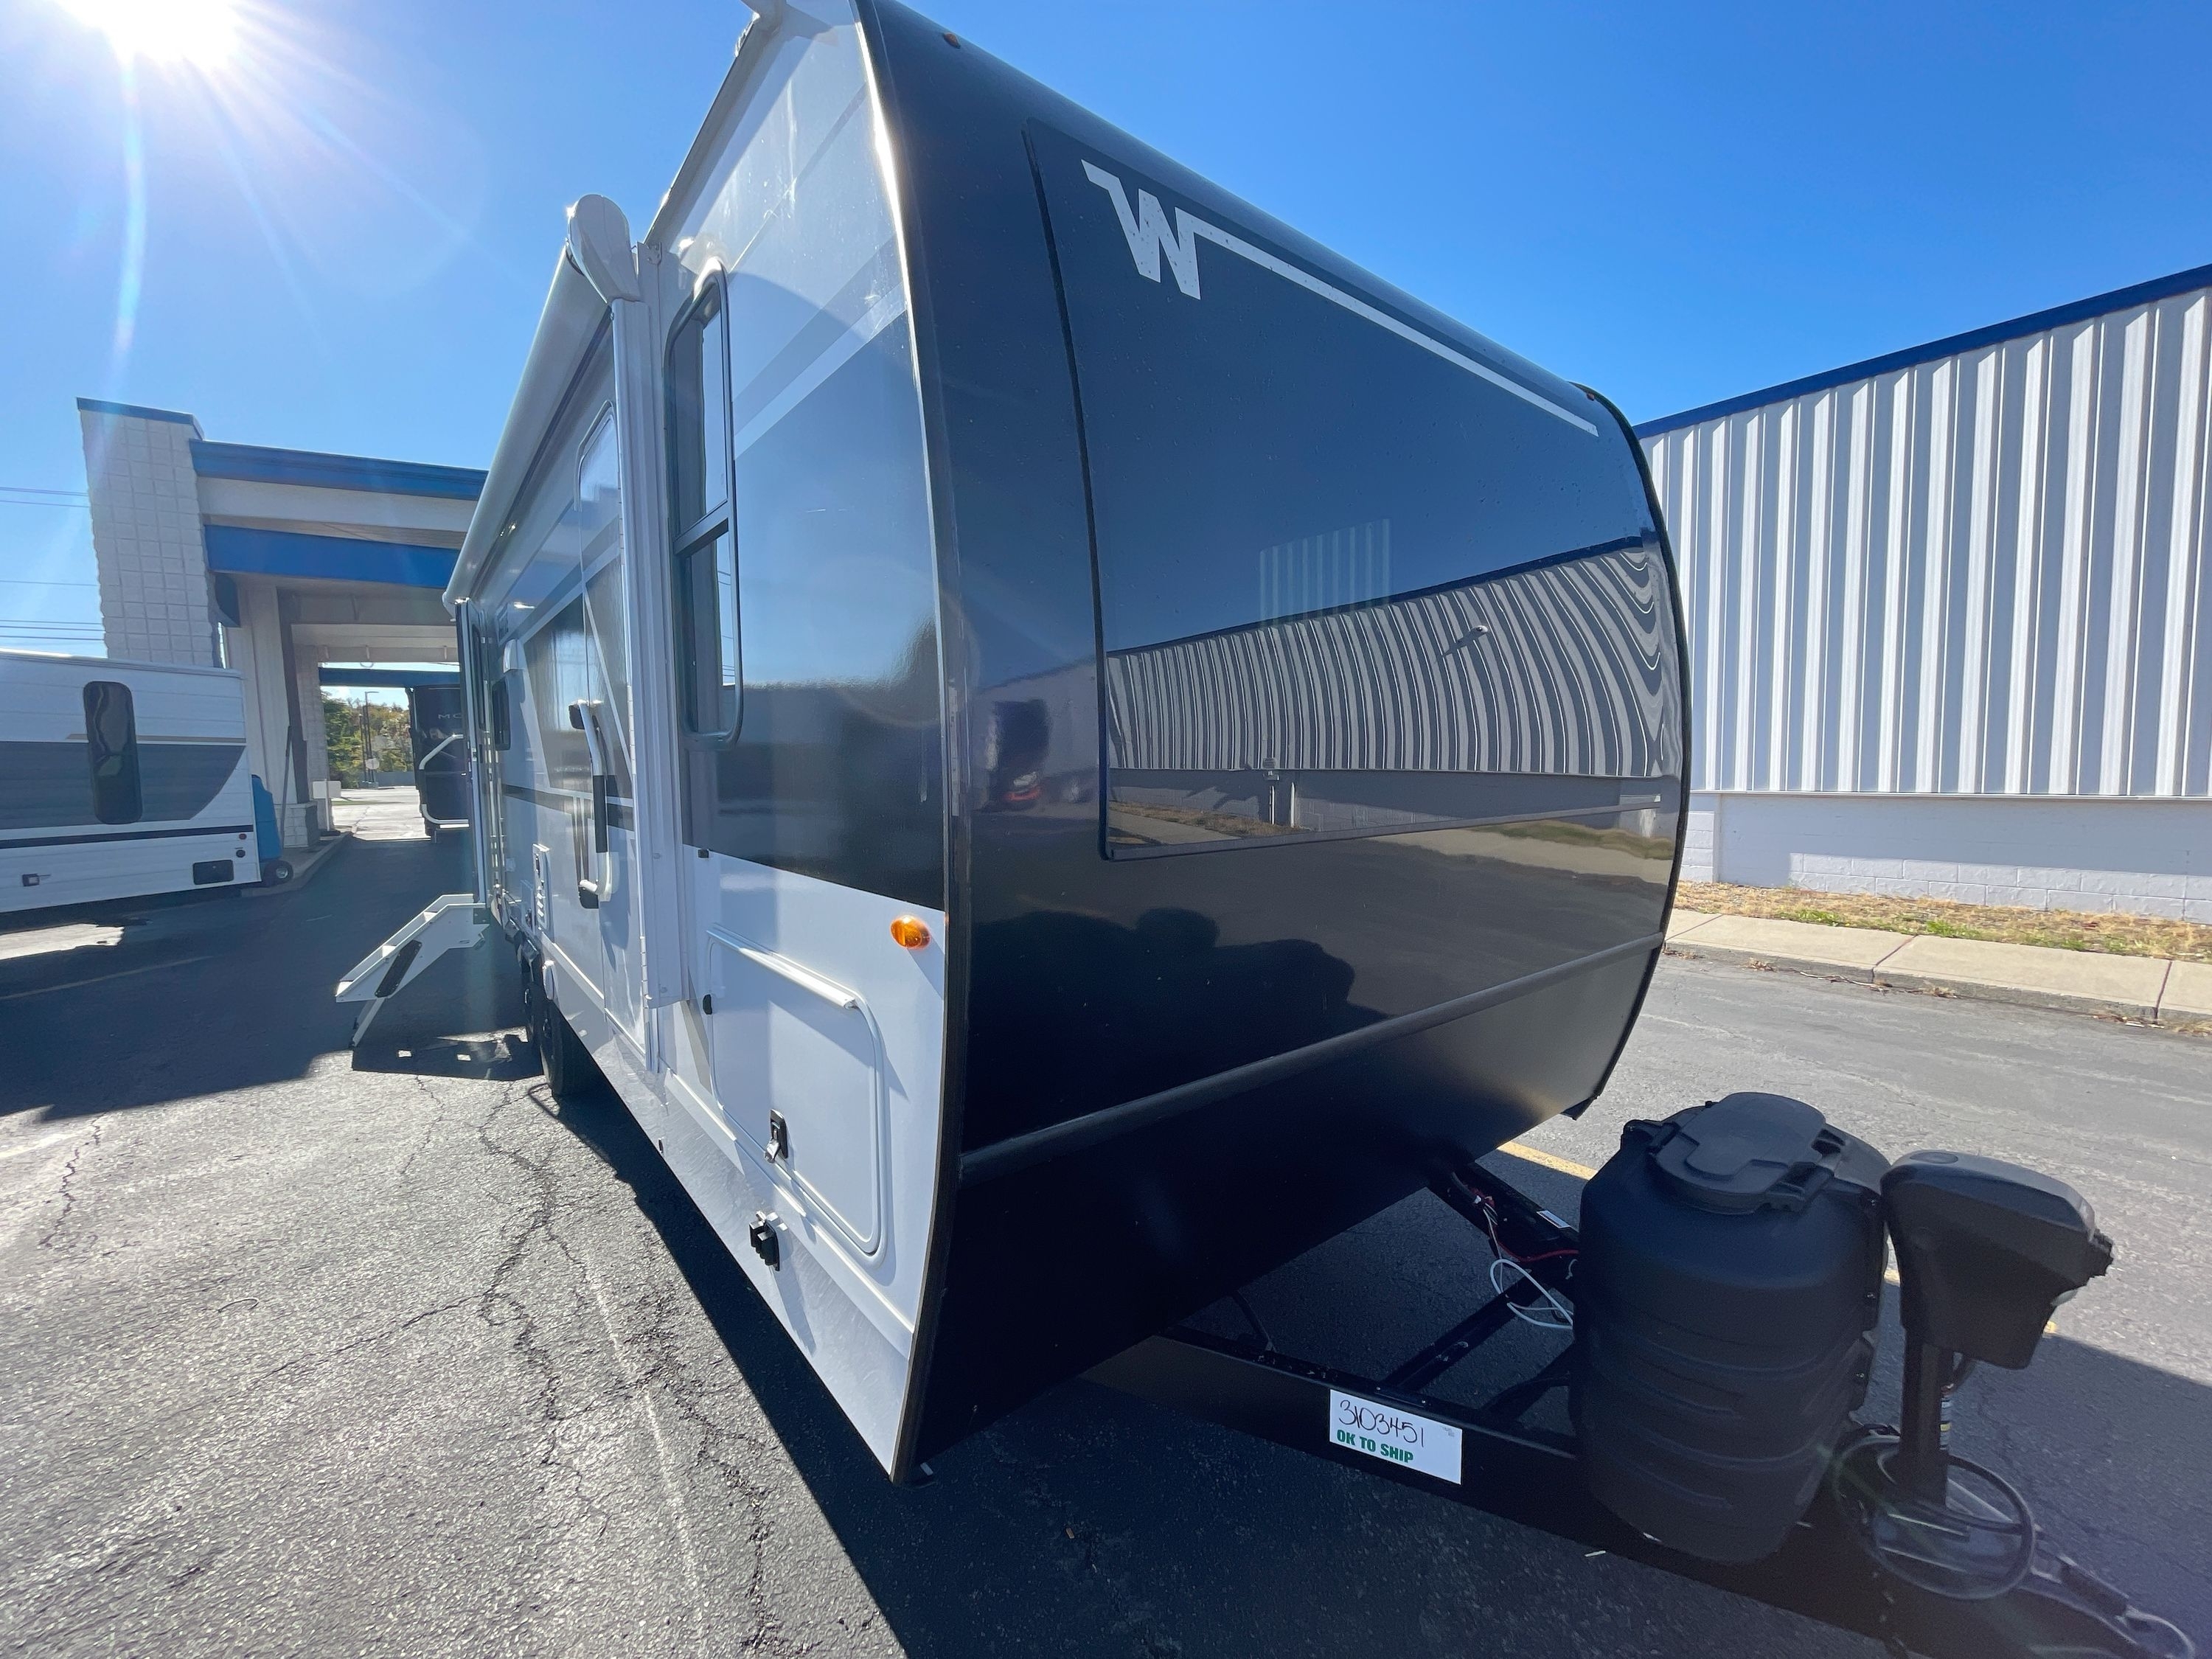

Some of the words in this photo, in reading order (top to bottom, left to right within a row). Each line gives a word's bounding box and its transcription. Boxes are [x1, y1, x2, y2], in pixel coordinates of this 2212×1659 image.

[1339, 1399, 1424, 1447] 3103451
[1337, 1429, 1356, 1446] OK
[1360, 1436, 1376, 1453] TO
[1380, 1444, 1413, 1463] SHIP
